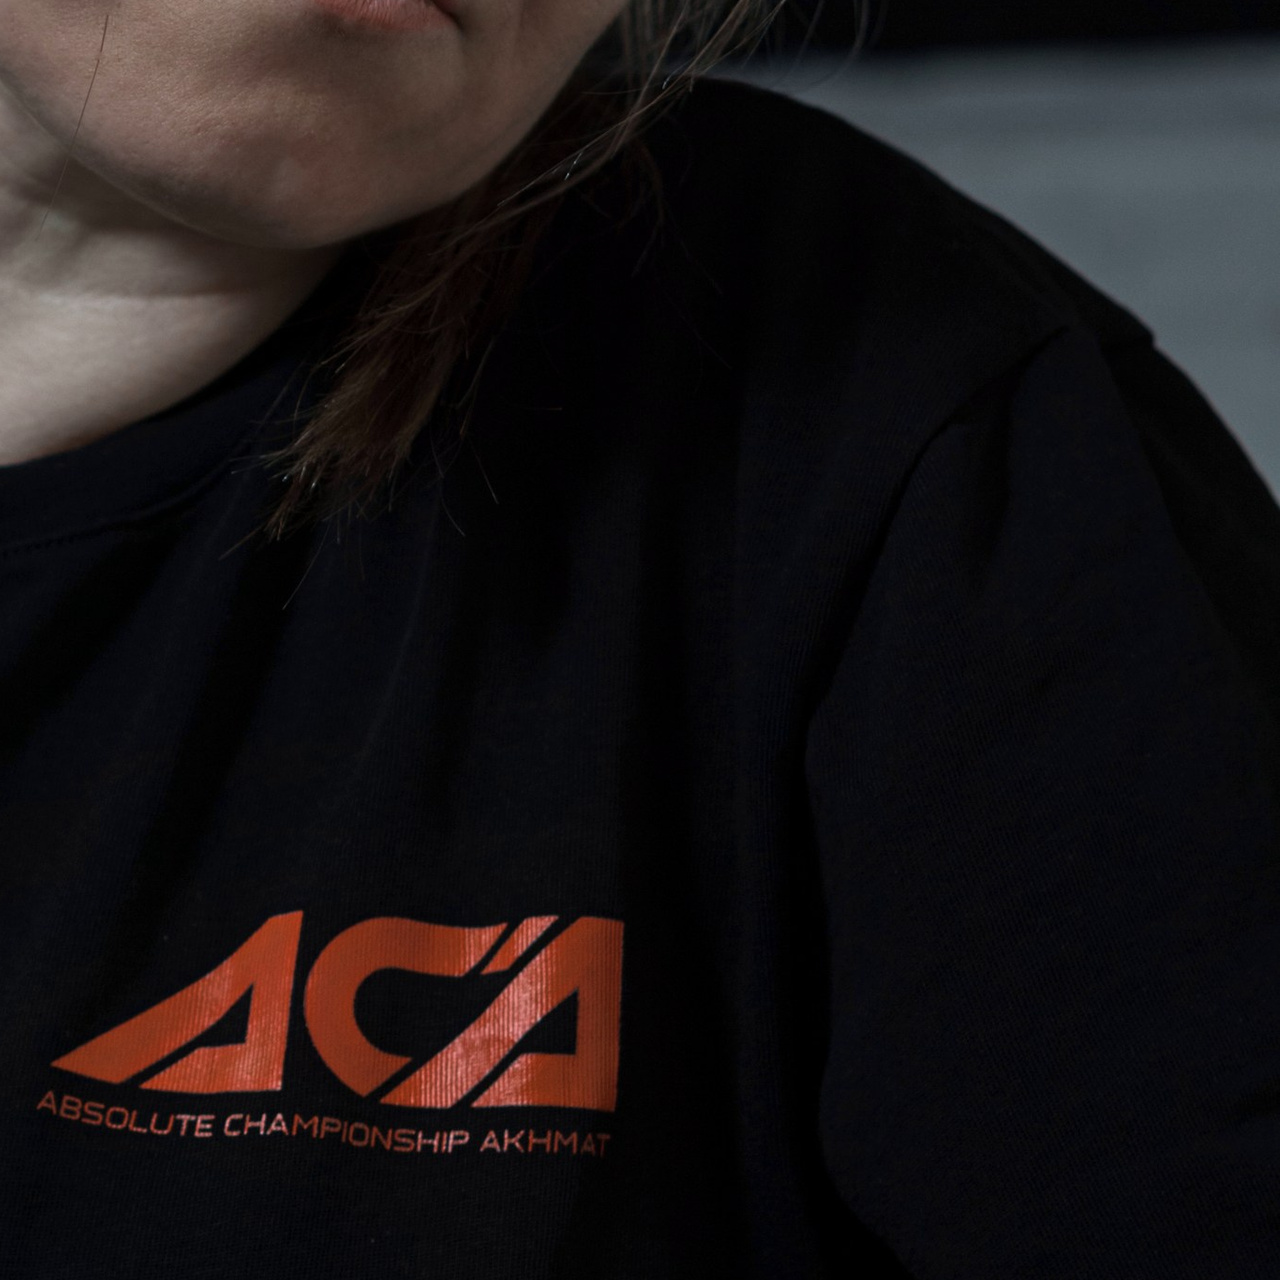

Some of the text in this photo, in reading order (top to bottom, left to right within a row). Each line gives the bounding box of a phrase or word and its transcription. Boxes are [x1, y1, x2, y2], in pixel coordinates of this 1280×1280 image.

[50, 909, 625, 1112] ACA
[35, 1090, 612, 1159] ABSOLUTE CHAMPIONSHIP AKHMAT
